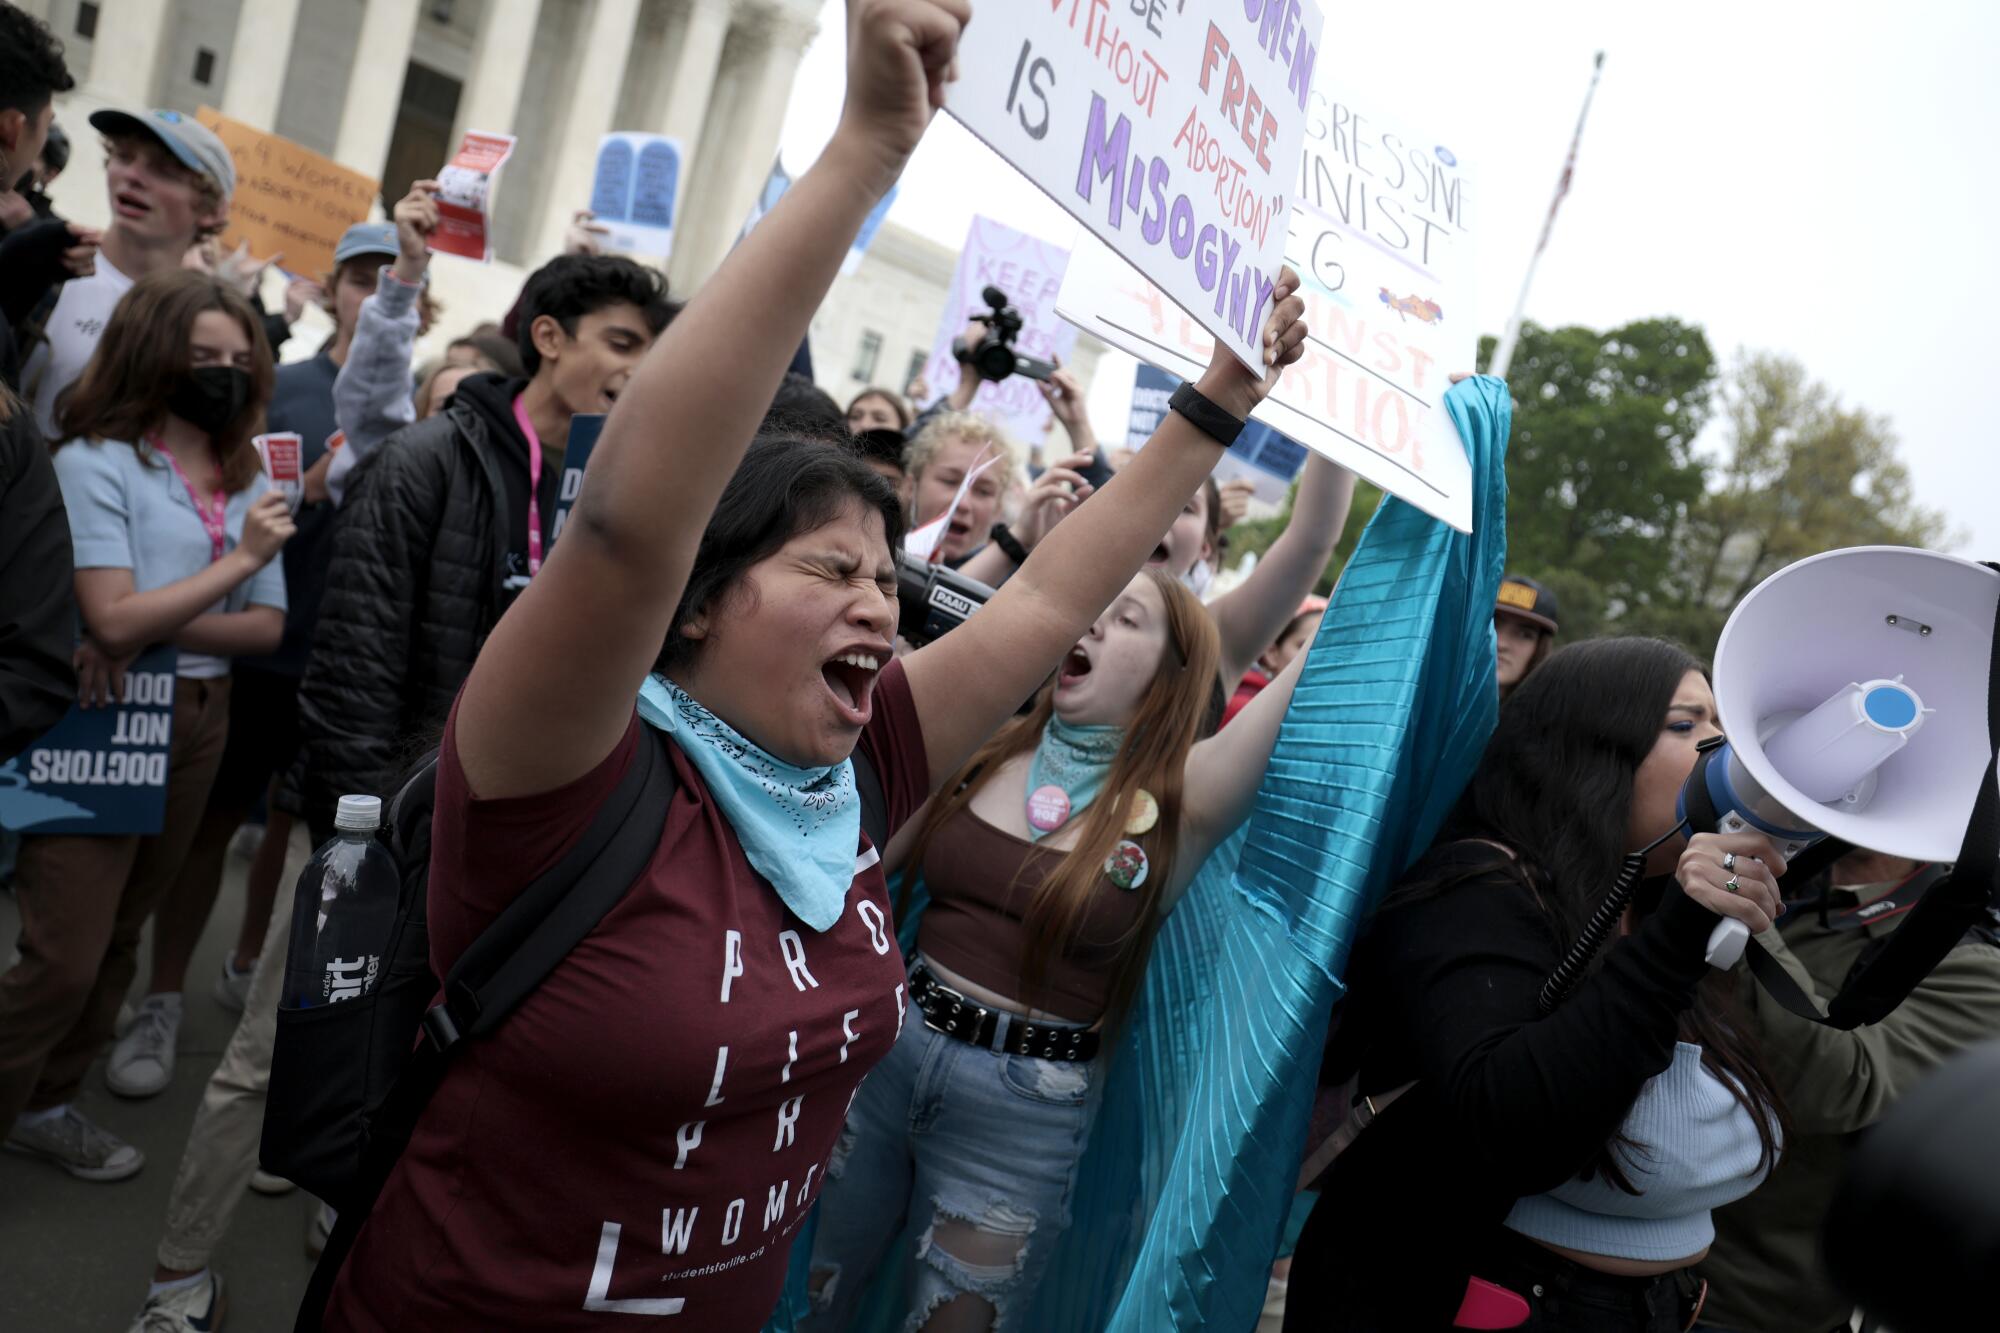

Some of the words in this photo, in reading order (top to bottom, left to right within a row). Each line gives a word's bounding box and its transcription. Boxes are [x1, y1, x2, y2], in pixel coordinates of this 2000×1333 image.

[1006, 38, 1056, 140] IS
[1199, 19, 1278, 175] FREE
[111, 710, 171, 747] NOT
[29, 748, 168, 787] DOCTORS
[719, 898, 890, 1003] PRO
[661, 1245, 766, 1282] studentsforlife.org
